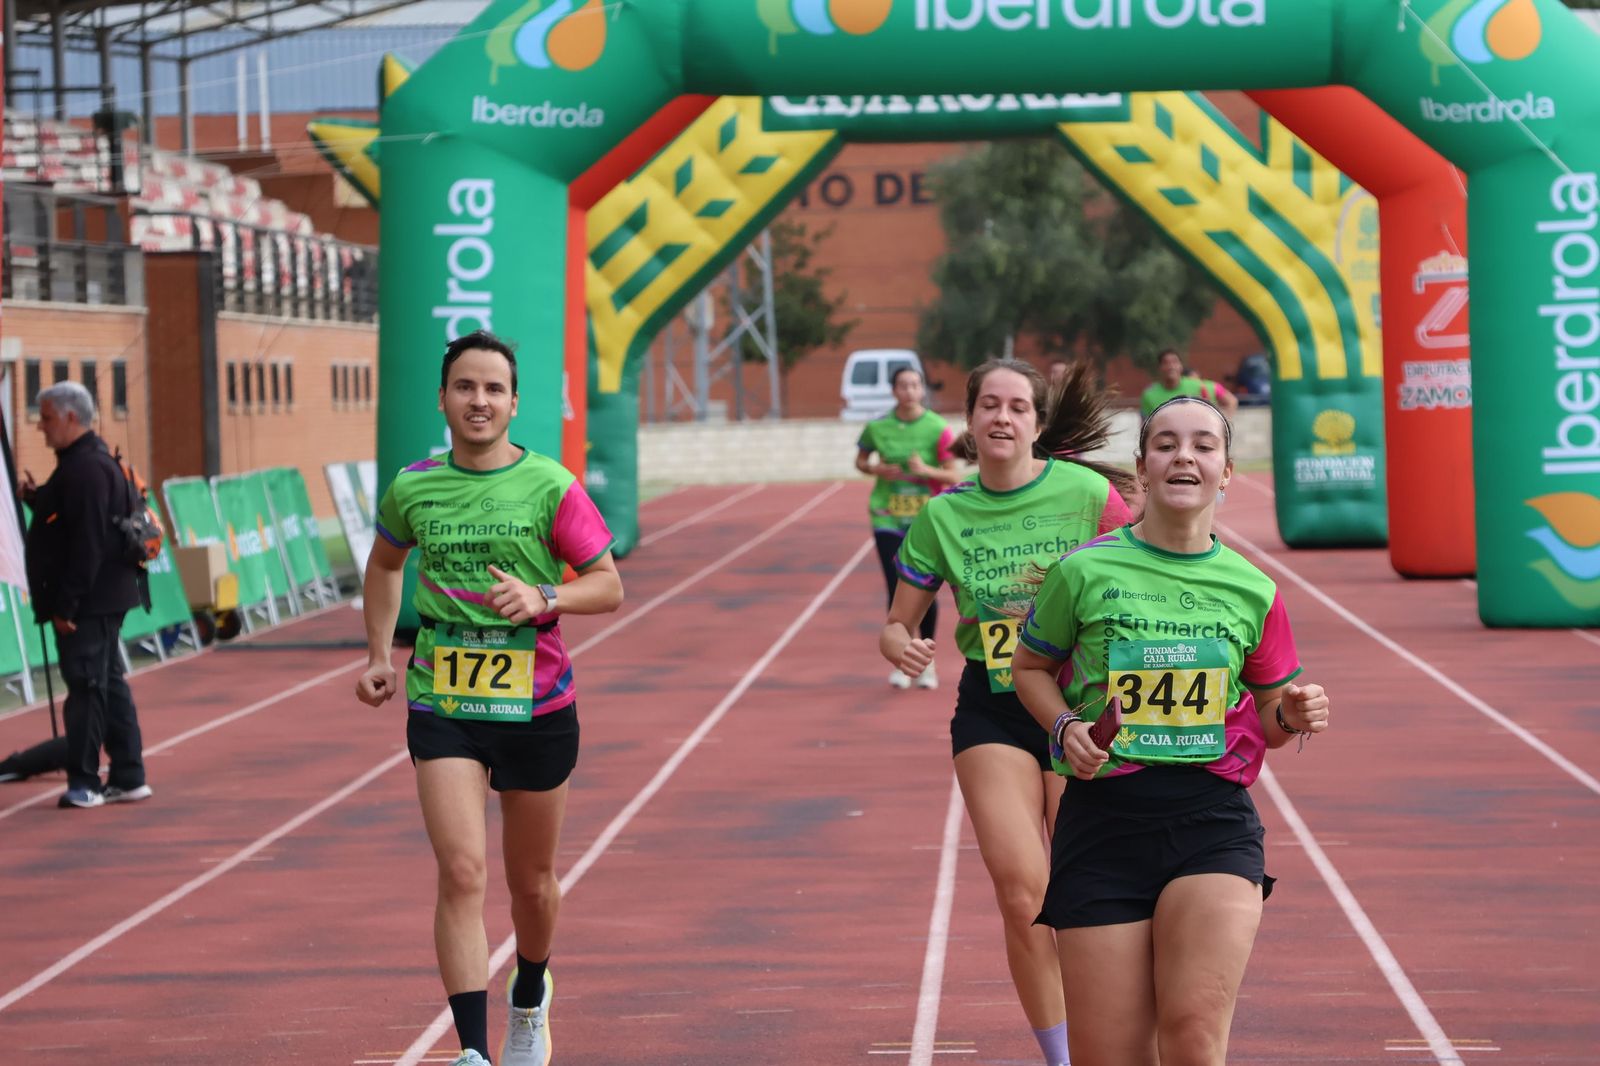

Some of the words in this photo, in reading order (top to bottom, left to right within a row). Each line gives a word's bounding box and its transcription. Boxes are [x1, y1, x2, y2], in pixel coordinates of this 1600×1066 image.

[472, 95, 604, 128] Iberdrola
[1420, 94, 1555, 123] Iberdrola
[1535, 171, 1600, 475] Iberdrola
[429, 520, 452, 536] En
[458, 521, 530, 537] marcha
[975, 522, 1012, 536] Iberdrola
[428, 540, 490, 554] contra
[974, 547, 997, 563] En
[1003, 537, 1079, 558] marcha
[432, 557, 448, 572] el
[975, 583, 993, 600] el
[1122, 590, 1167, 604] Iberdrola
[1118, 613, 1149, 631] En
[1144, 653, 1166, 663] CAJA
[1168, 652, 1198, 663] RURAL
[443, 651, 512, 689] 172
[1117, 671, 1209, 716] 344
[461, 703, 487, 713] CAJA
[490, 704, 527, 715] RURAL
[1140, 733, 1173, 746] CAJA
[1176, 733, 1219, 746] RURAL
